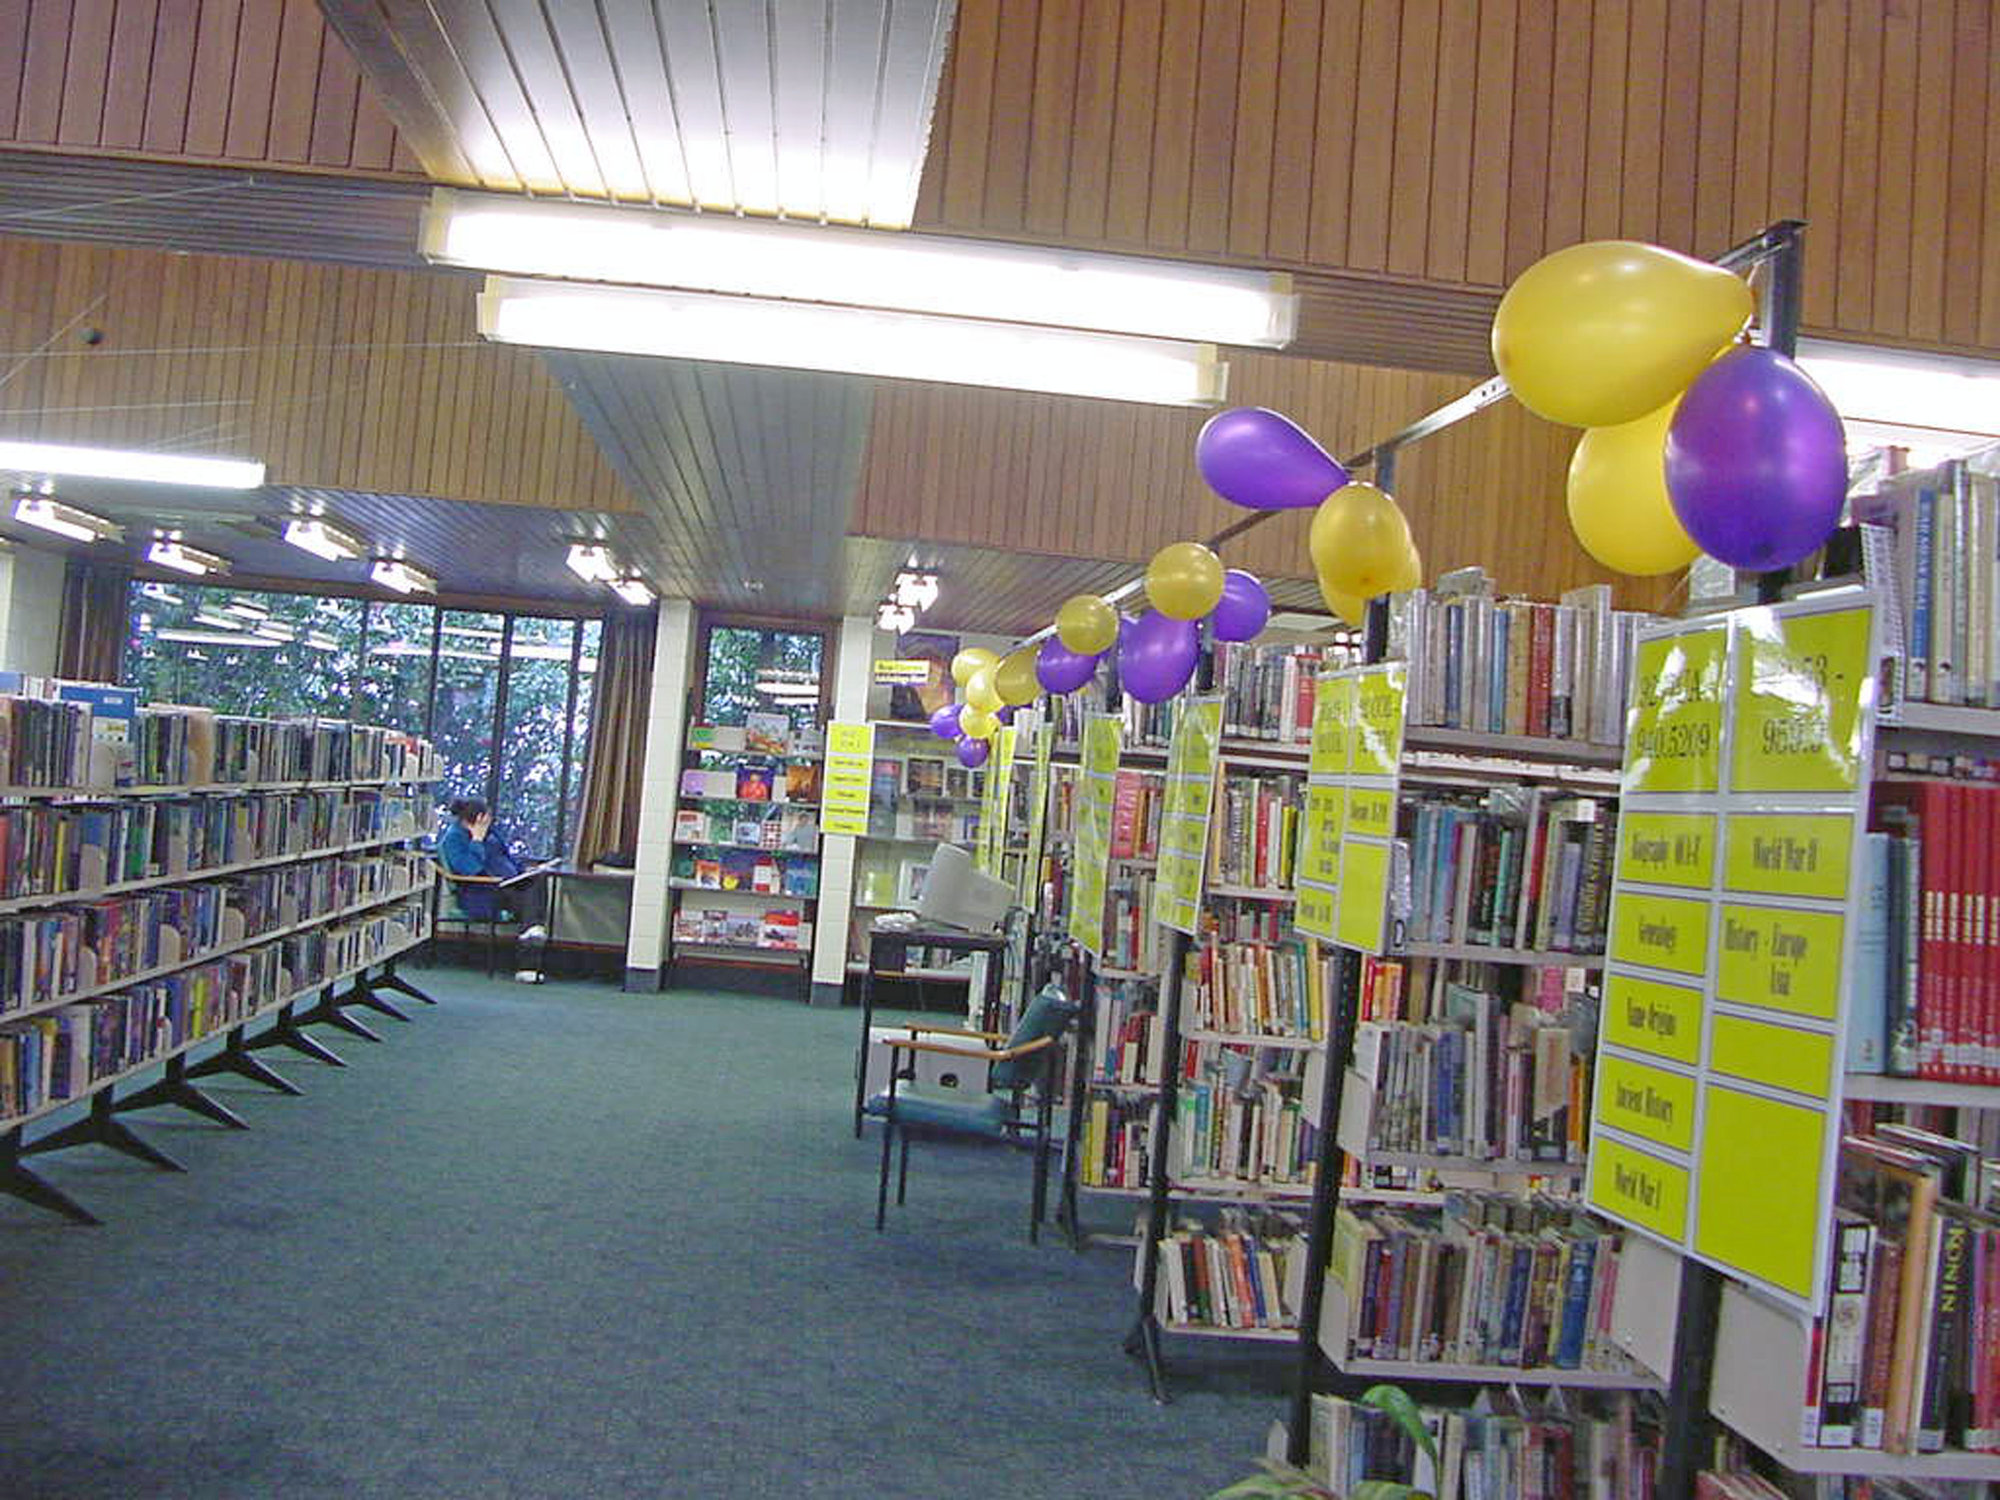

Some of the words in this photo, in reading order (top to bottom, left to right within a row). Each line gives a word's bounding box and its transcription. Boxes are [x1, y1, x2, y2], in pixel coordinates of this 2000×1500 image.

[1752, 835, 1781, 871] World
[1783, 836, 1805, 871] War
[1724, 918, 1759, 961] History
[1771, 922, 1808, 967] Europe
[1940, 1227, 1967, 1312] KONIN
